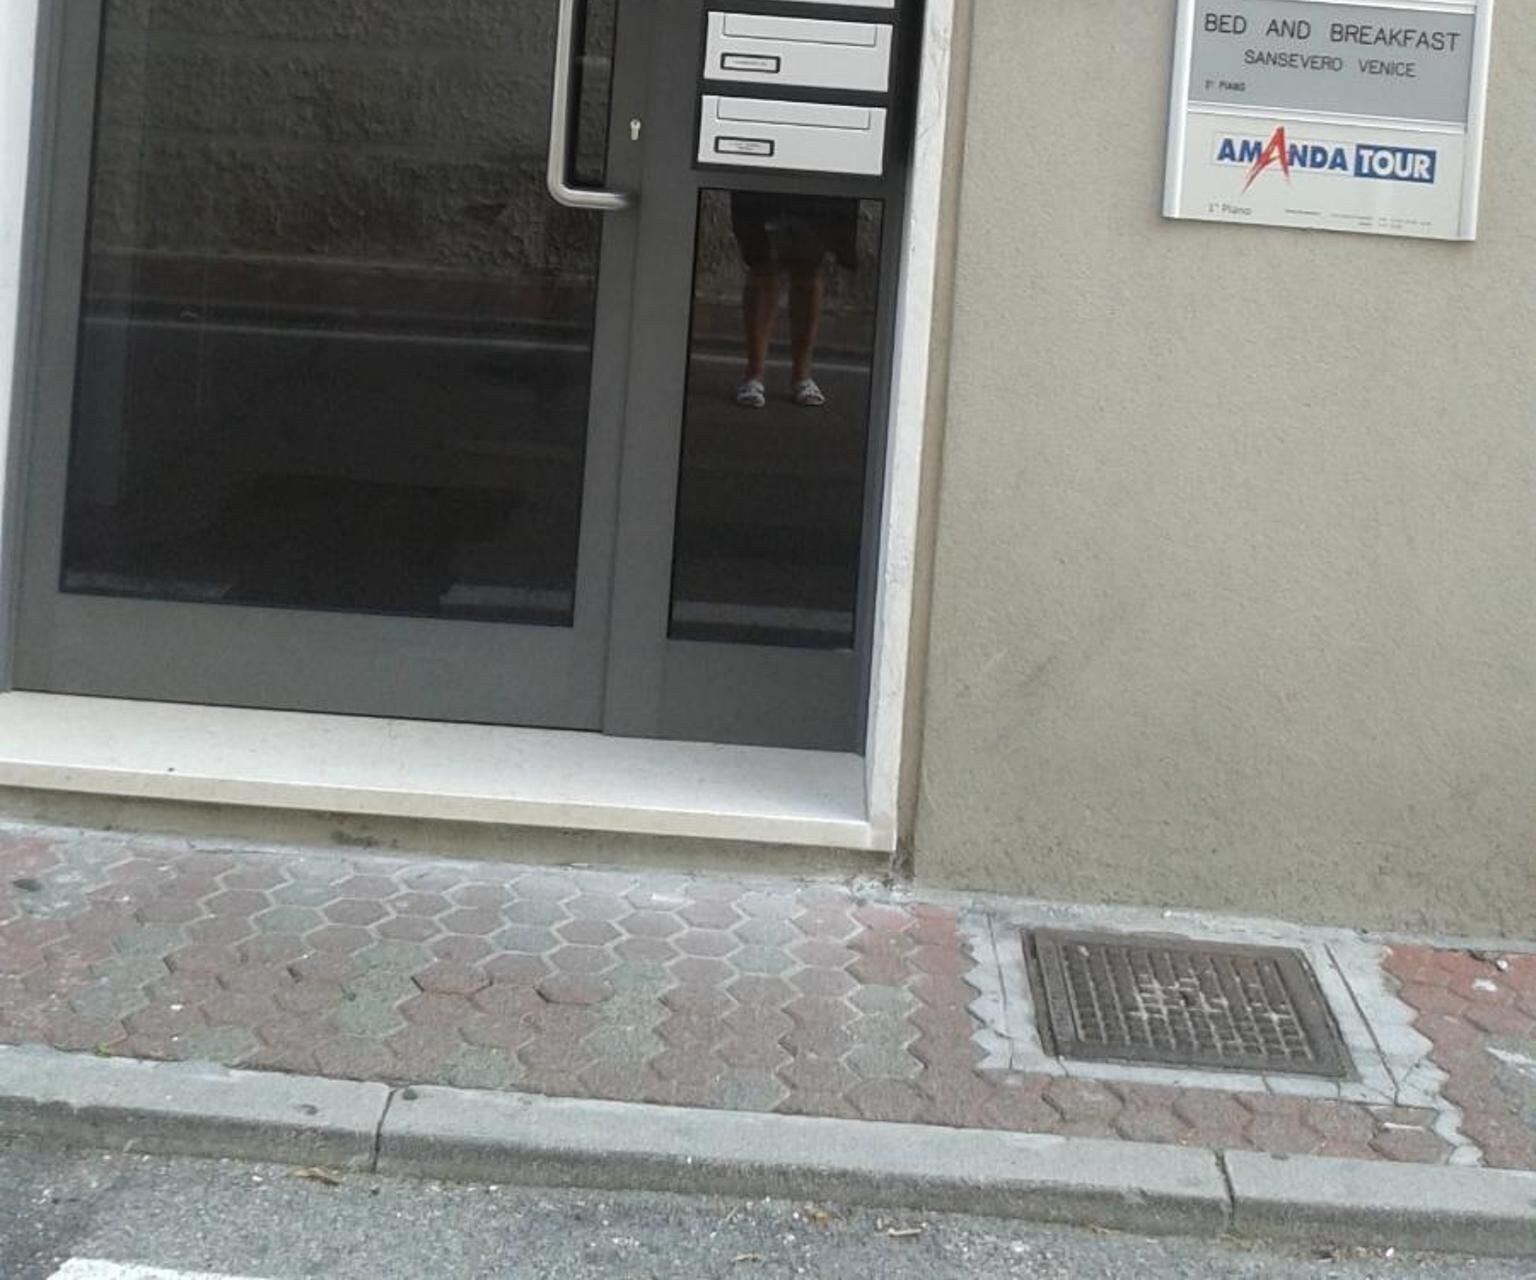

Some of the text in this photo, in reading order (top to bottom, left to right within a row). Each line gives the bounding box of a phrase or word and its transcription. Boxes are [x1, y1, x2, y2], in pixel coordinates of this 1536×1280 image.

[1204, 13, 1462, 52] BED AND BREAKFAST
[1243, 48, 1417, 78] SANSEVERO VENICE
[1217, 126, 1432, 193] AMANDA TOUR
